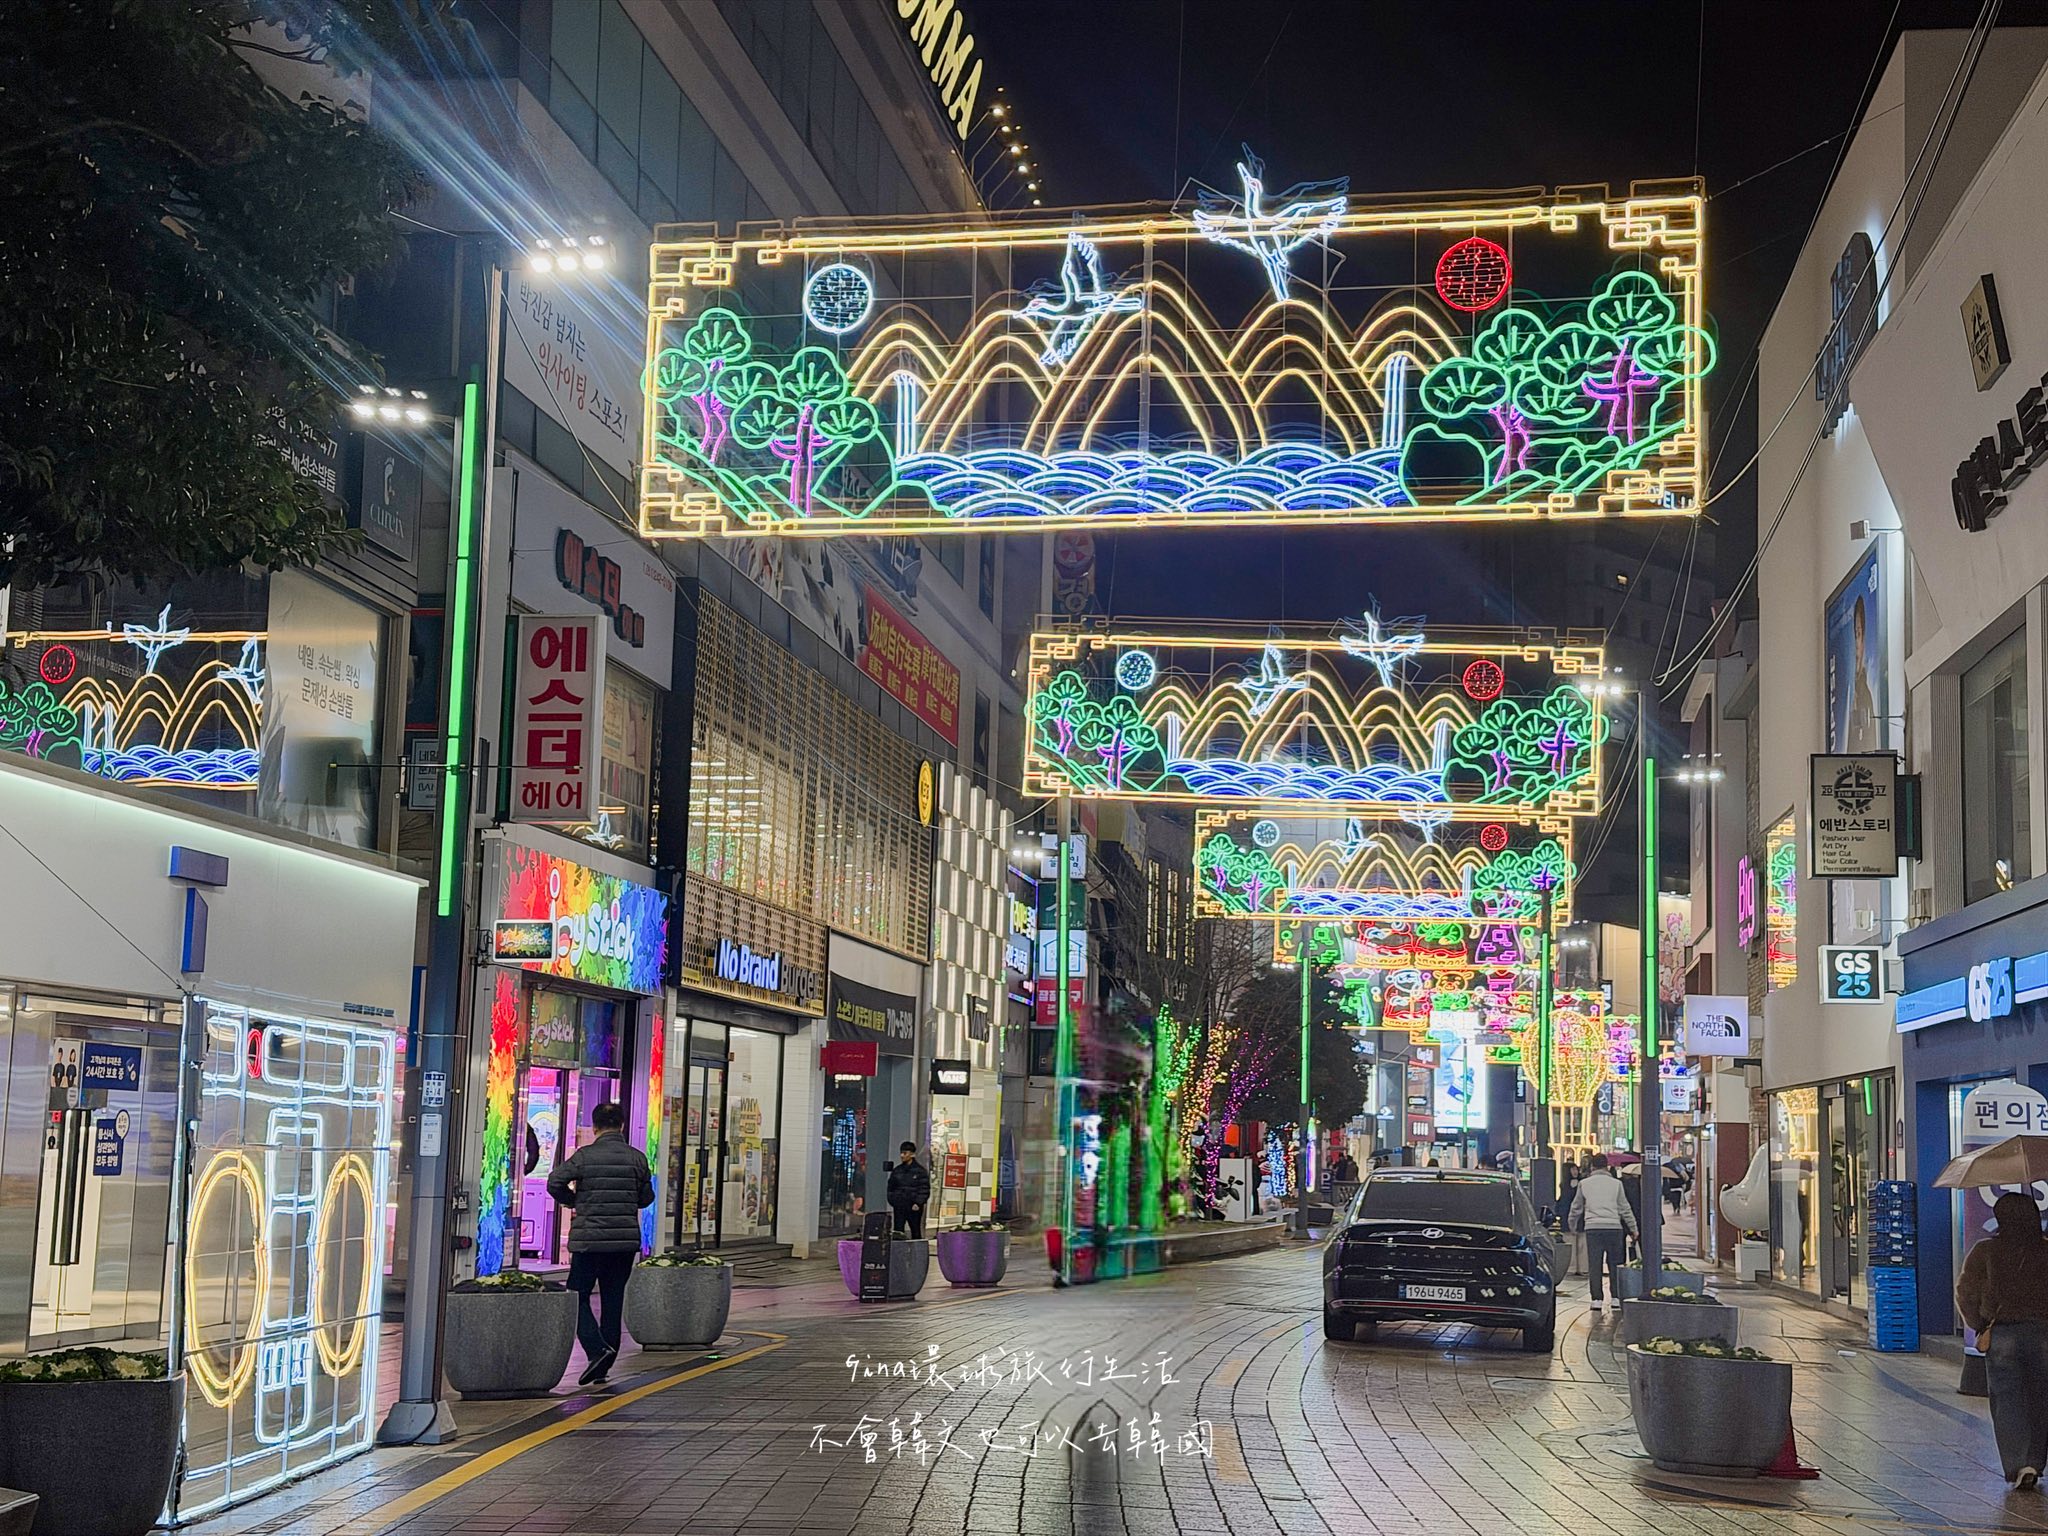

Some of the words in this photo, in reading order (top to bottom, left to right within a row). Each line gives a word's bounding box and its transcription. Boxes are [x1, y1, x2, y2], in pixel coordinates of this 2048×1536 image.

[520, 280, 553, 332] 박진감
[556, 312, 586, 363] 넘치는
[538, 342, 587, 411] 익사이팅
[345, 664, 361, 690] 왁싱
[301, 677, 328, 710] 문제성
[328, 689, 354, 720] 손발톱
[527, 625, 588, 775] 에스더
[521, 781, 583, 810] 헤어
[1819, 818, 1890, 833] 에반스토리
[1838, 850, 1852, 858] Cut
[718, 938, 739, 981] No
[739, 944, 779, 991] Brand
[1834, 951, 1872, 975] GS
[1836, 974, 1871, 997] 25
[1968, 956, 2012, 1023] GS25
[1691, 1021, 1725, 1030] NORTH
[1706, 1014, 1725, 1022] THE
[1700, 1029, 1725, 1038] FACE
[85, 1065, 106, 1079] 24시간
[105, 1067, 118, 1079] 보호
[937, 1070, 968, 1084] VANS
[1437, 1288, 1464, 1300] 9465
